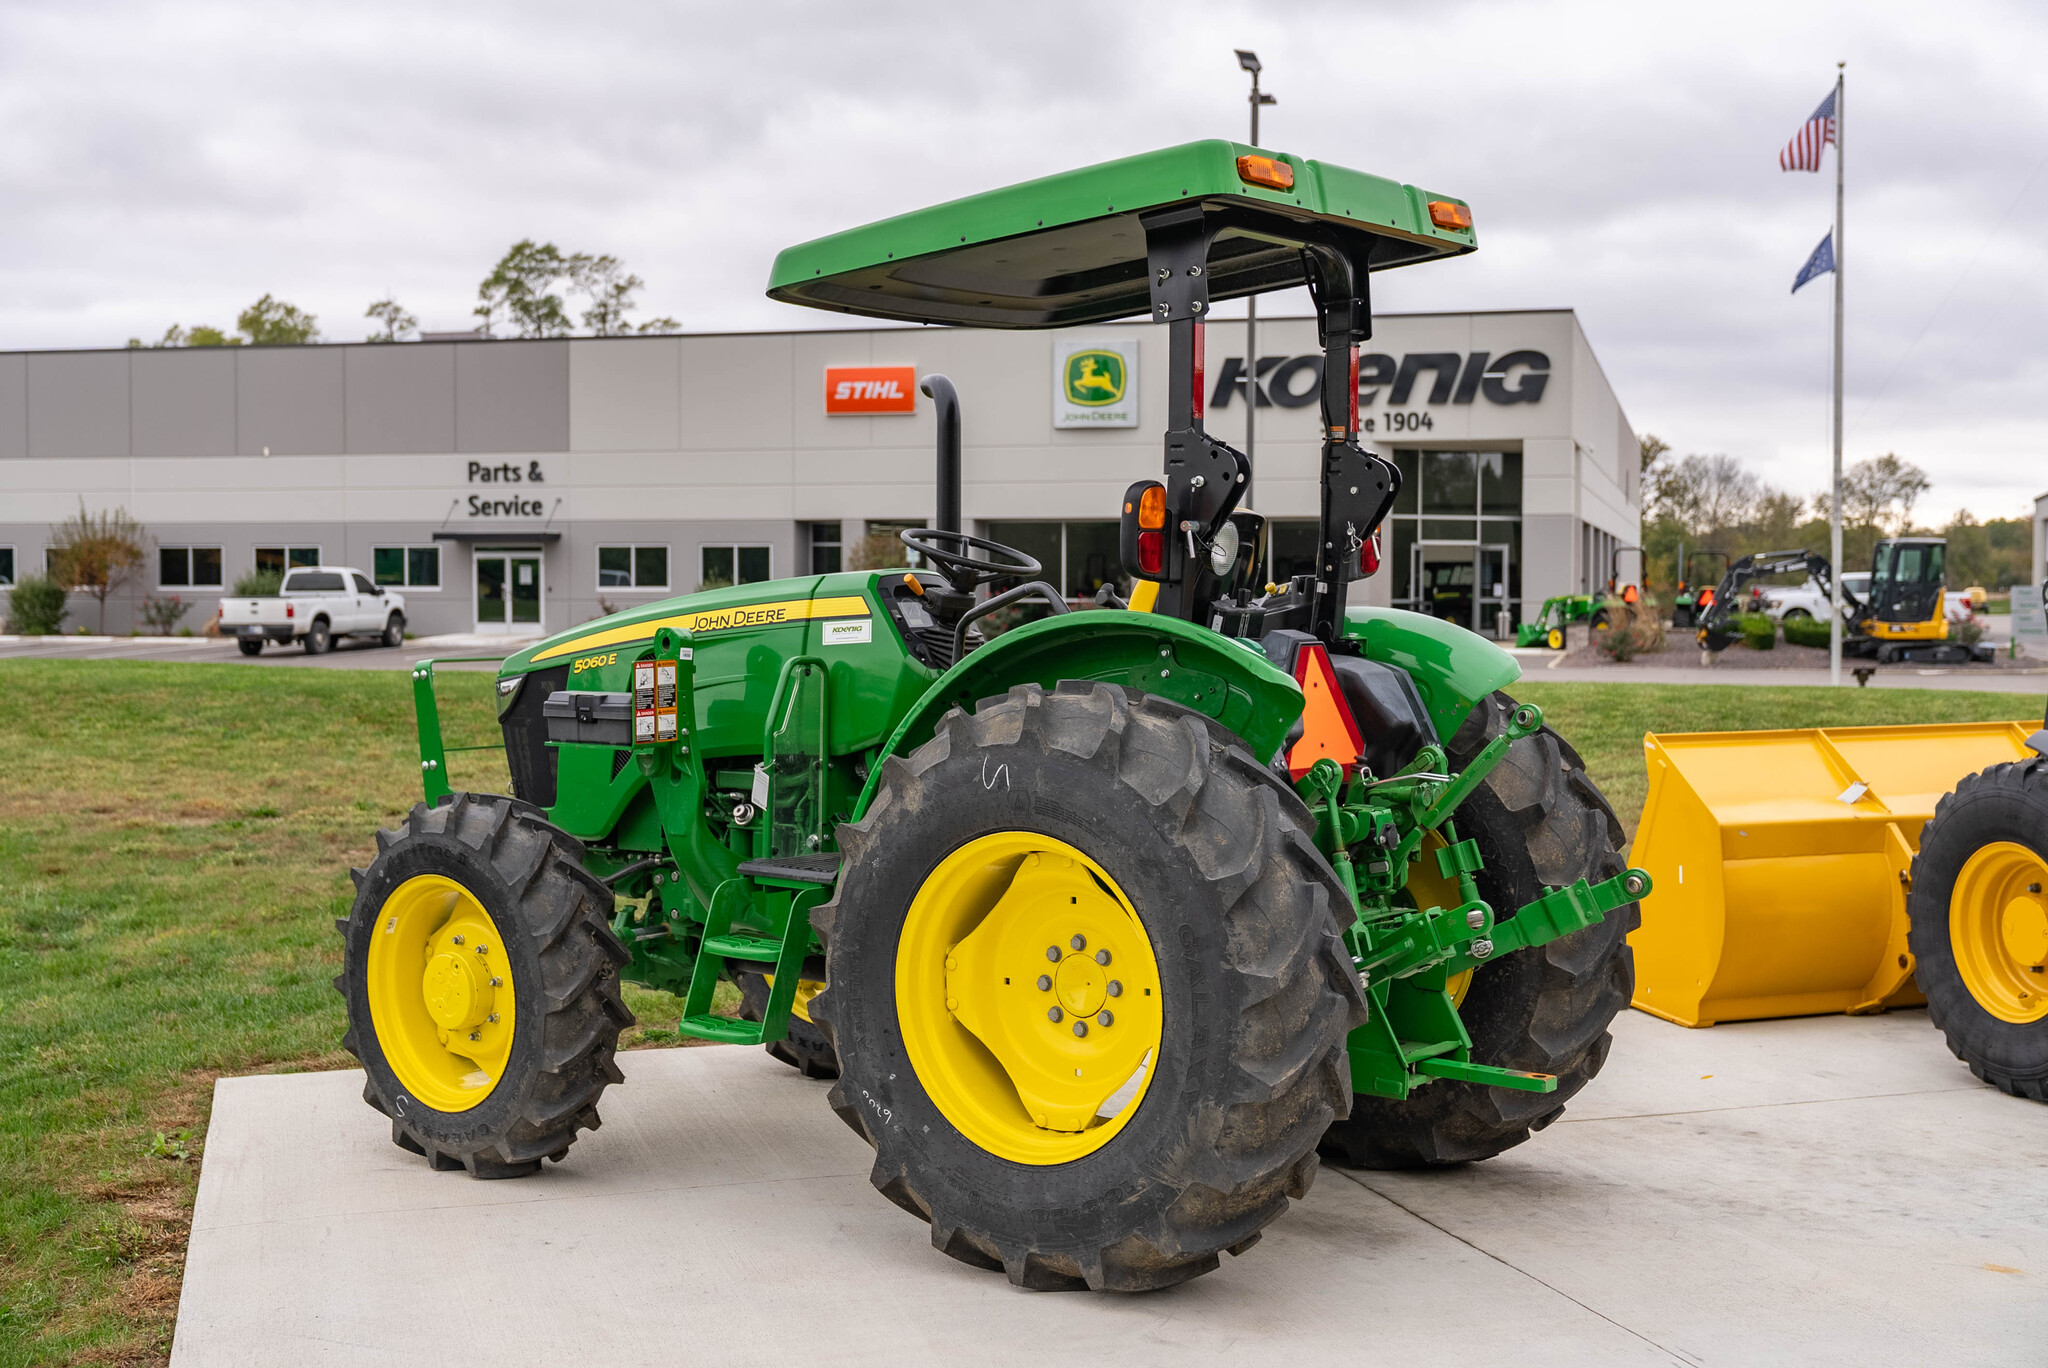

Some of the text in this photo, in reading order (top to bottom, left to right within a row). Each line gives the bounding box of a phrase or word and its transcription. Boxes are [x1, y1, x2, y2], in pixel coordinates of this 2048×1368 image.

[835, 381, 904, 399] STIHL
[1063, 410, 1129, 422] JOHN DEERE
[1384, 412, 1433, 431] 1904
[468, 460, 545, 483] Parts &
[468, 494, 543, 517] Service
[691, 608, 786, 630] JOHN DEERE
[574, 652, 618, 674] 5060 E
[1178, 922, 1209, 1104] GALAXY
